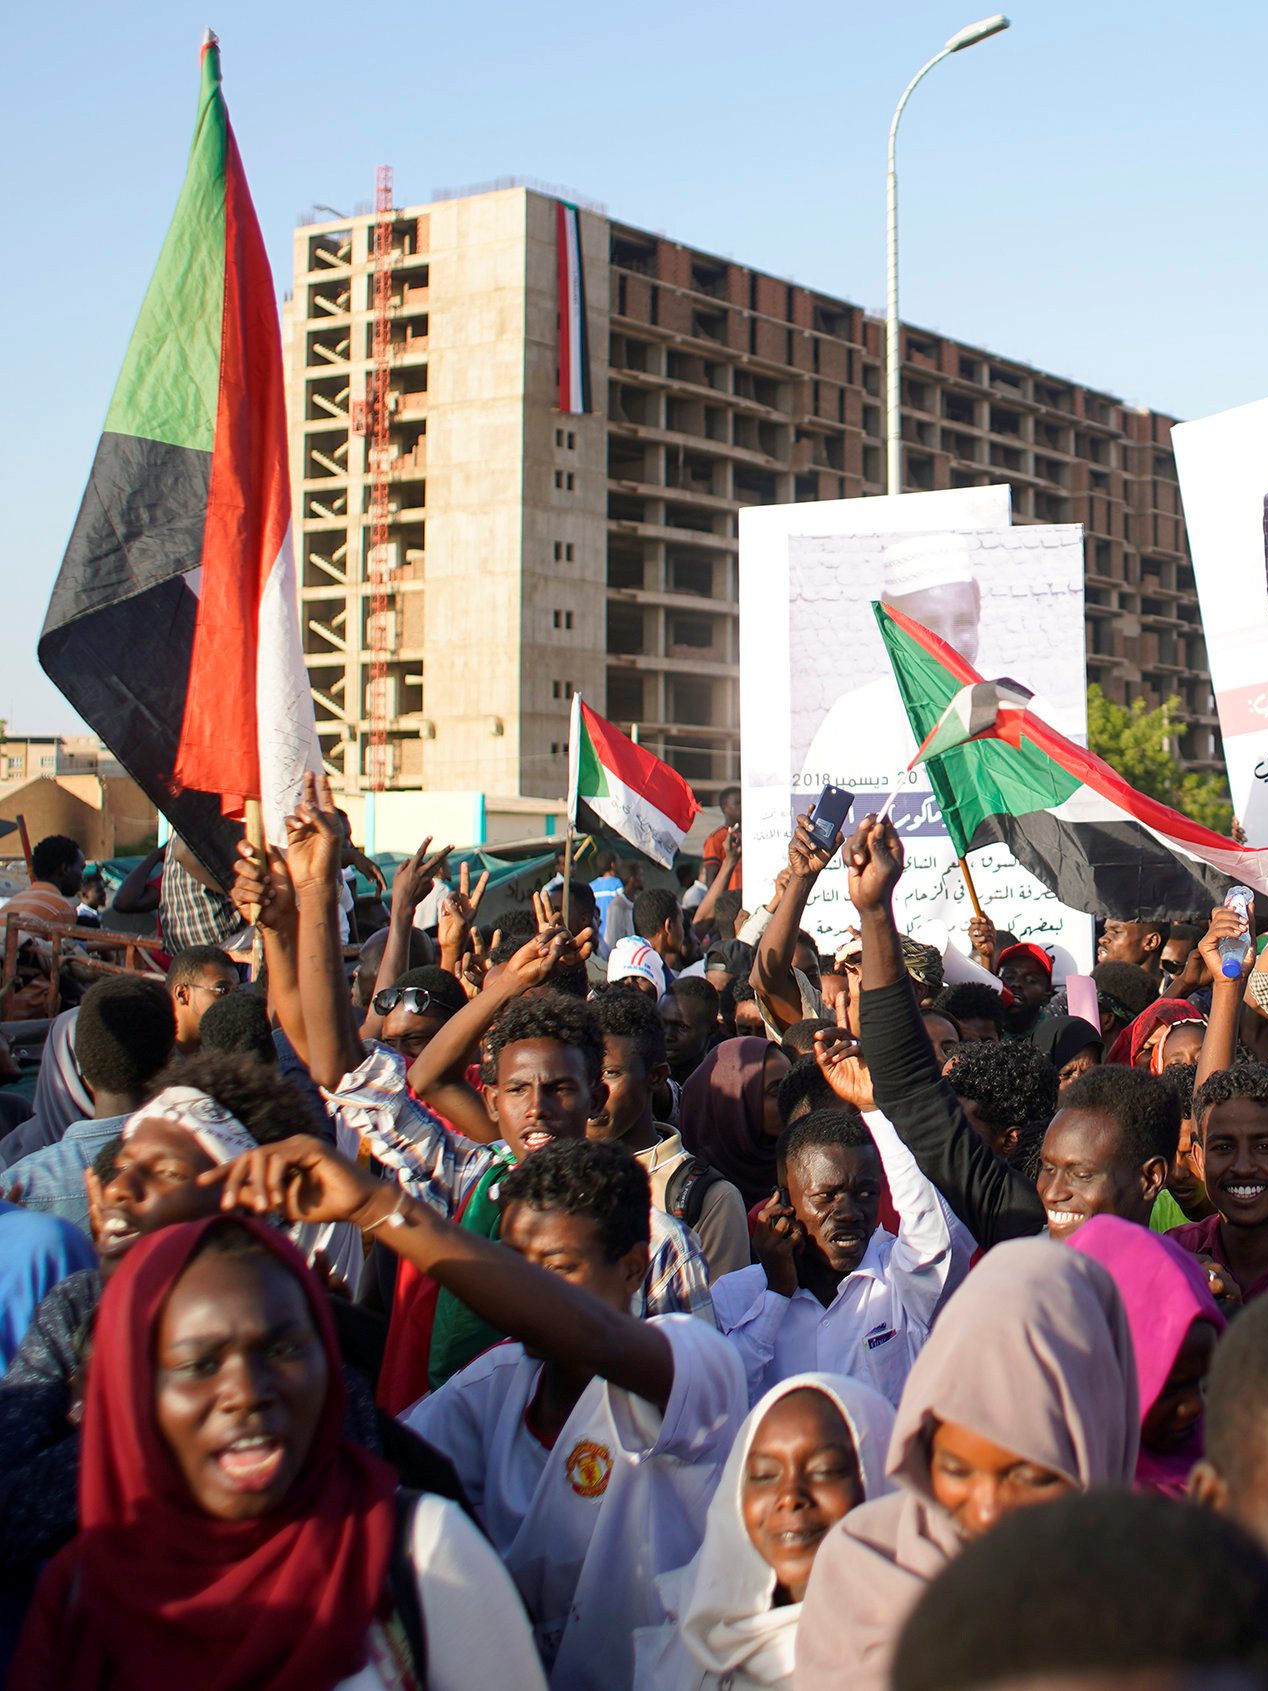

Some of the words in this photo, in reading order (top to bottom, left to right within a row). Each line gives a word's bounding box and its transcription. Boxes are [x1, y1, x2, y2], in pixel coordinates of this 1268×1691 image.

[791, 772, 831, 787] 2018
[834, 776, 889, 788] ديسمبر
[806, 888, 839, 906] الناس
[904, 881, 949, 909] الزحام
[953, 879, 965, 904] في
